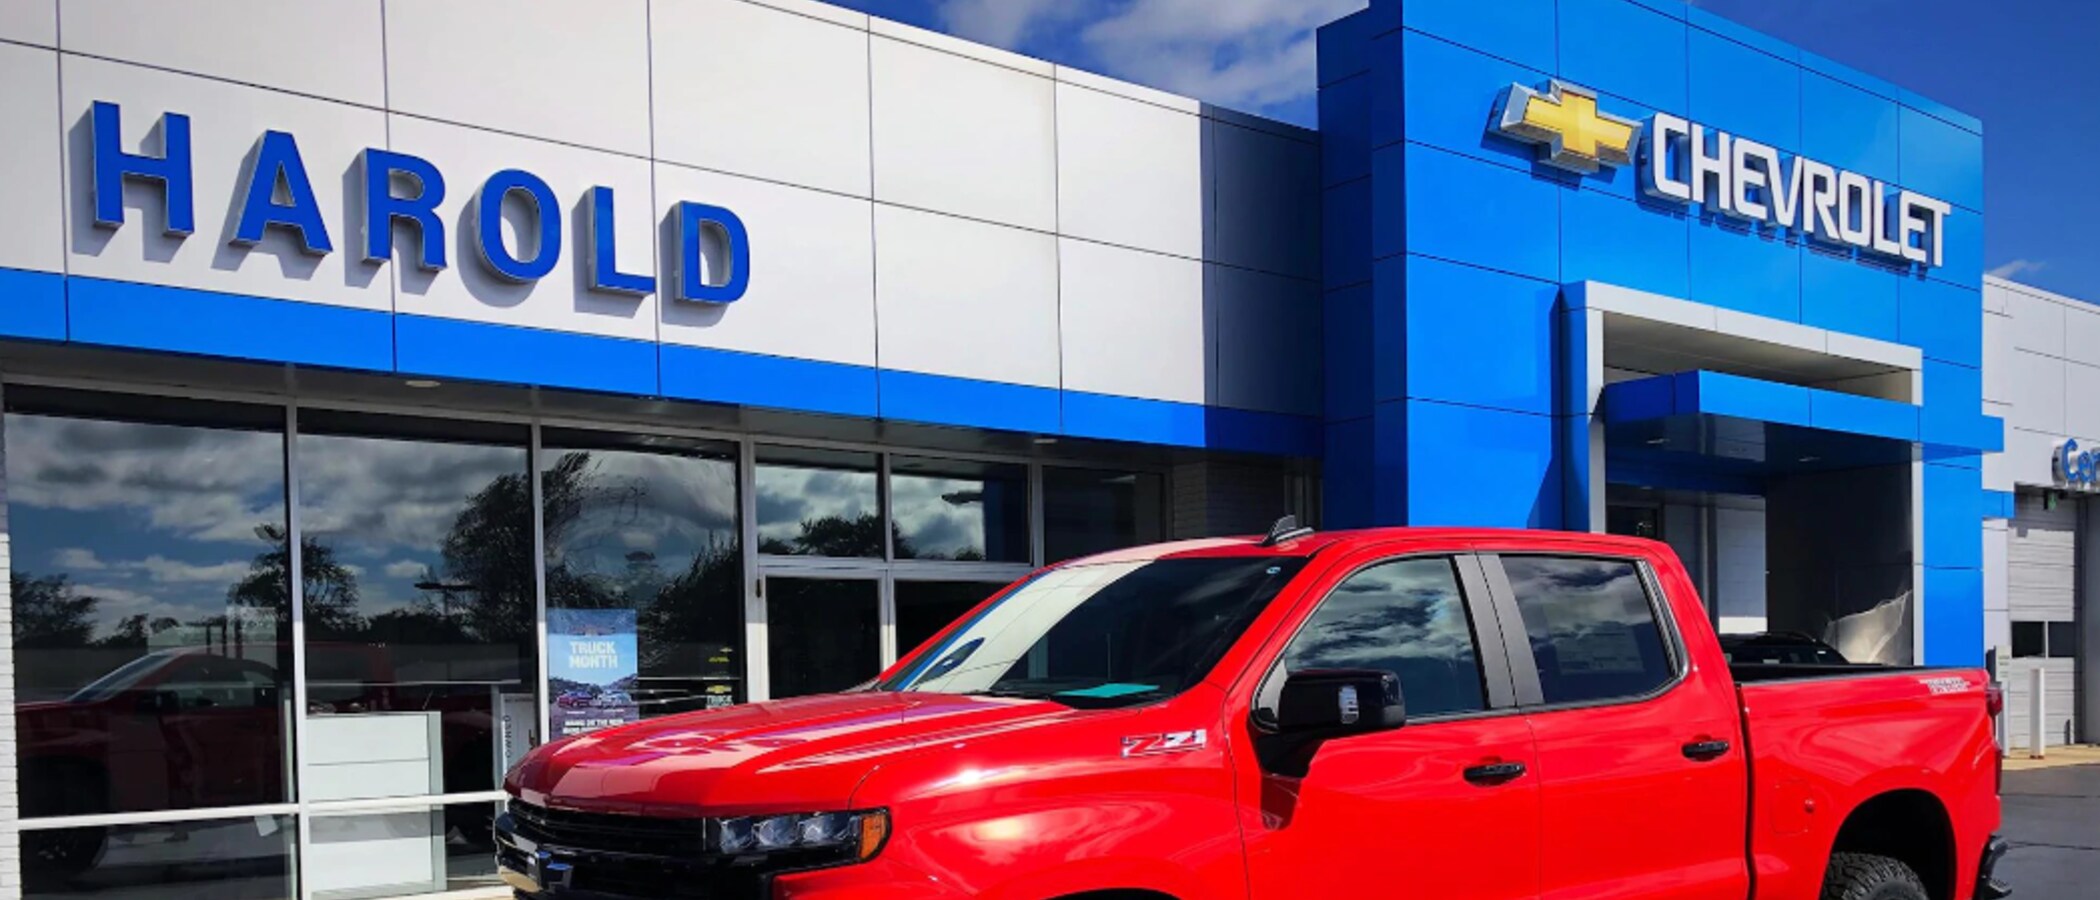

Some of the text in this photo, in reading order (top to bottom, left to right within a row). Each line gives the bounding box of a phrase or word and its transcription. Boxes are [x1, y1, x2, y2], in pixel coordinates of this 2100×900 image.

[92, 100, 750, 304] HAROLD
[1643, 112, 1952, 268] CHEVROLET
[569, 641, 616, 654] TRUCK
[569, 655, 618, 668] MONTH
[1121, 729, 1207, 758] Z71
